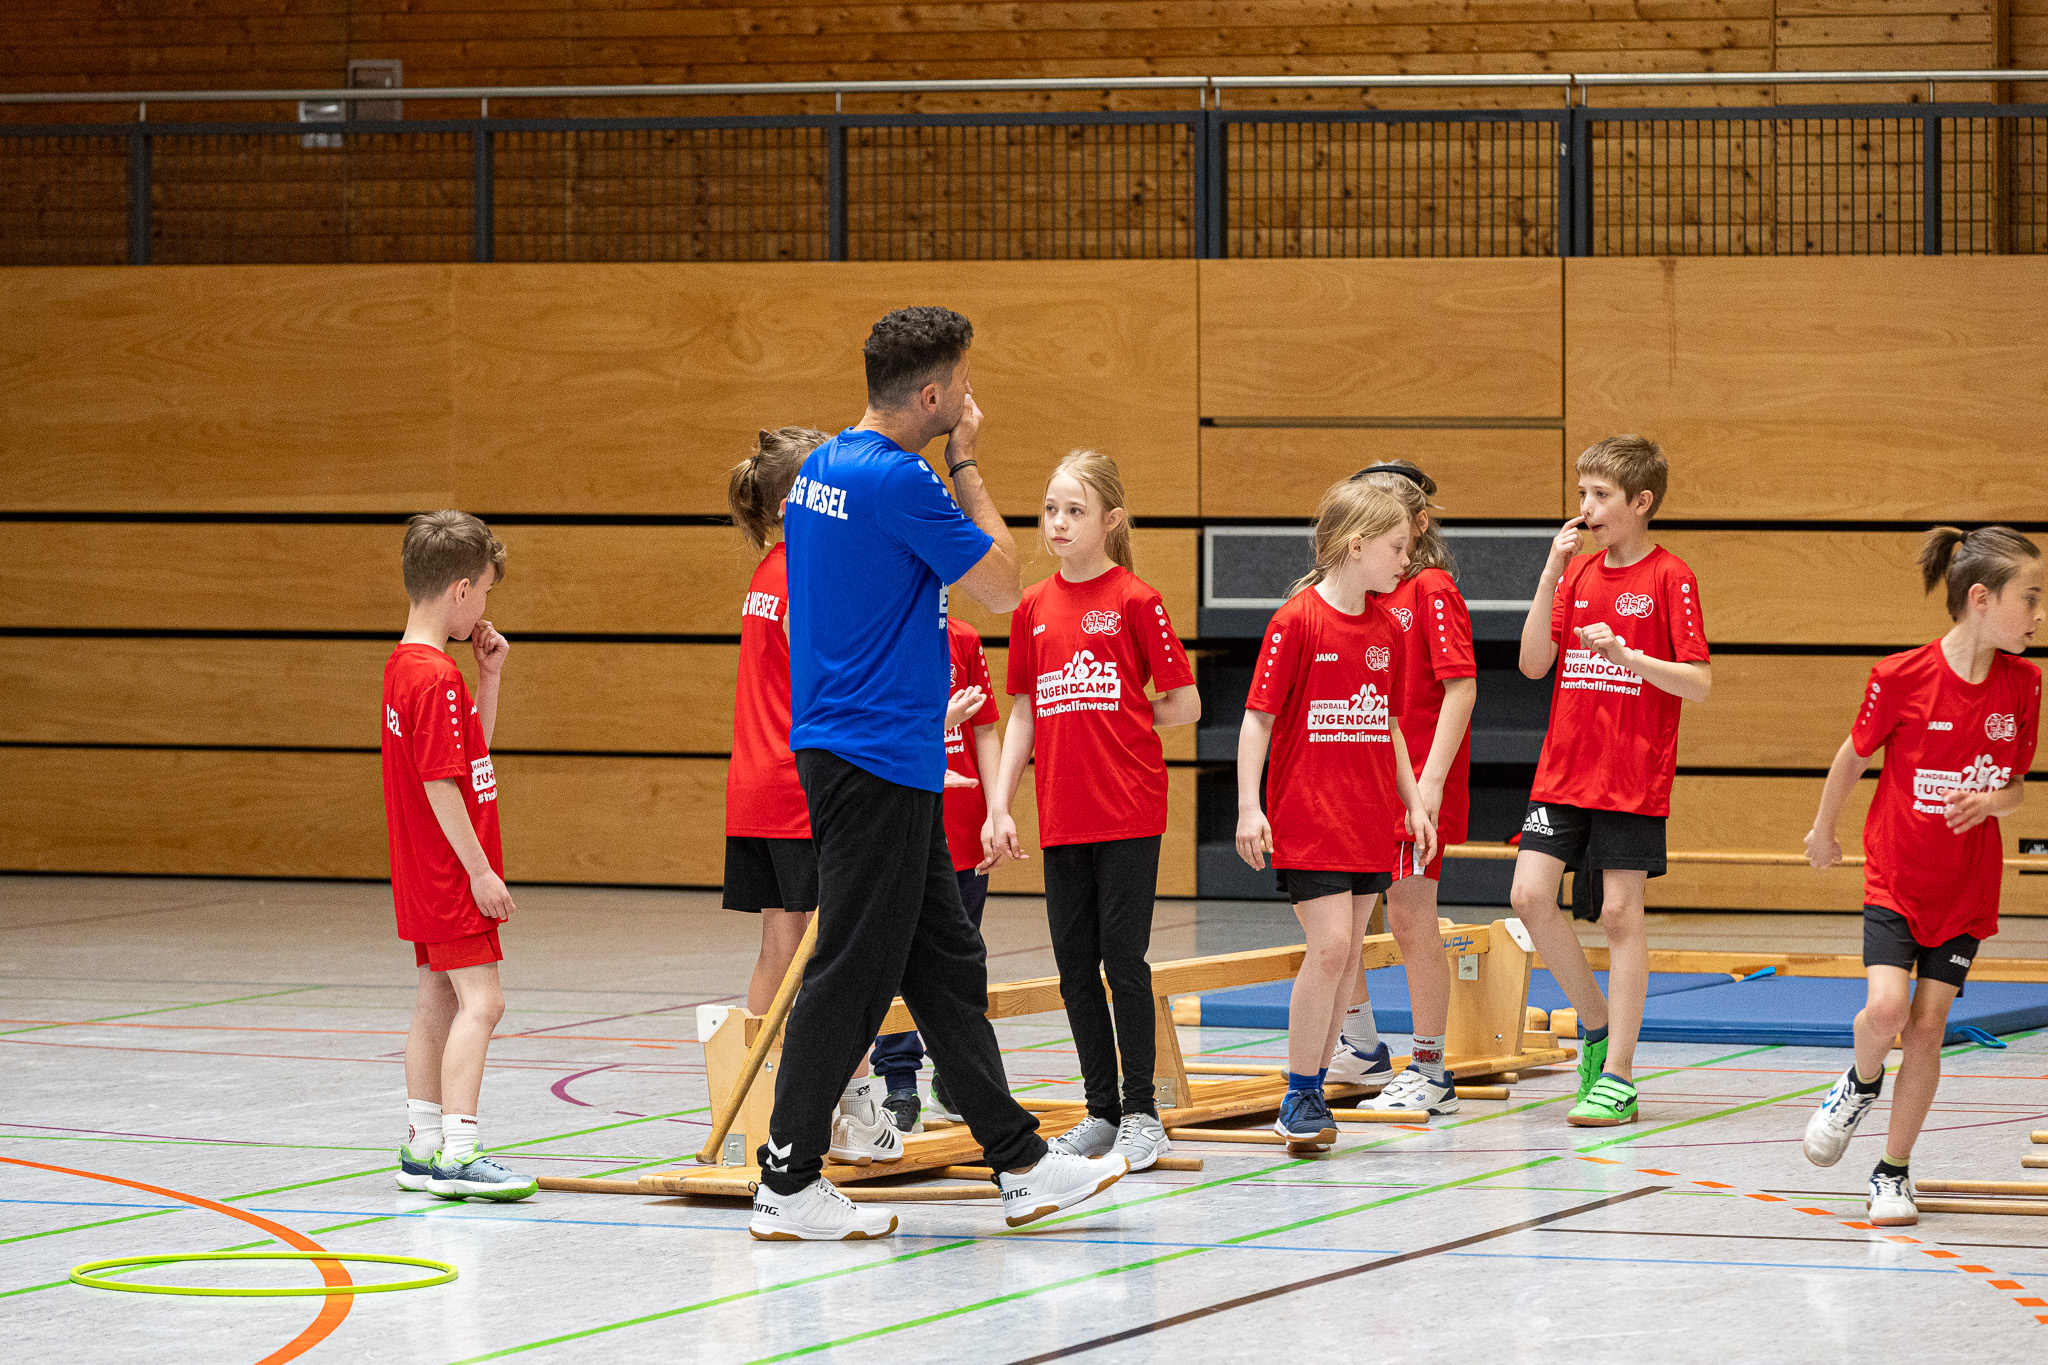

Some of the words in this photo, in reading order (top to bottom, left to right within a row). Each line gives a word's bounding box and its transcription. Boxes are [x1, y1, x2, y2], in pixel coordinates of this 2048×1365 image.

[788, 475, 807, 505] SG
[805, 479, 848, 520] WESEL
[748, 591, 779, 621] WESEL
[1574, 599, 1588, 608] AKO
[1032, 623, 1045, 636] AKO
[1314, 652, 1338, 661] JAKO
[1564, 662, 1638, 678] UGENDCAM
[1037, 674, 1061, 684] ANDBALL
[1311, 714, 1386, 725] JUGENDCAM
[1927, 720, 1953, 730] JAKO
[1308, 731, 1390, 742] #handballinwese
[1919, 772, 1958, 782] ANDBALL
[1521, 821, 1553, 835] adidas
[1949, 954, 1969, 967] JAKO
